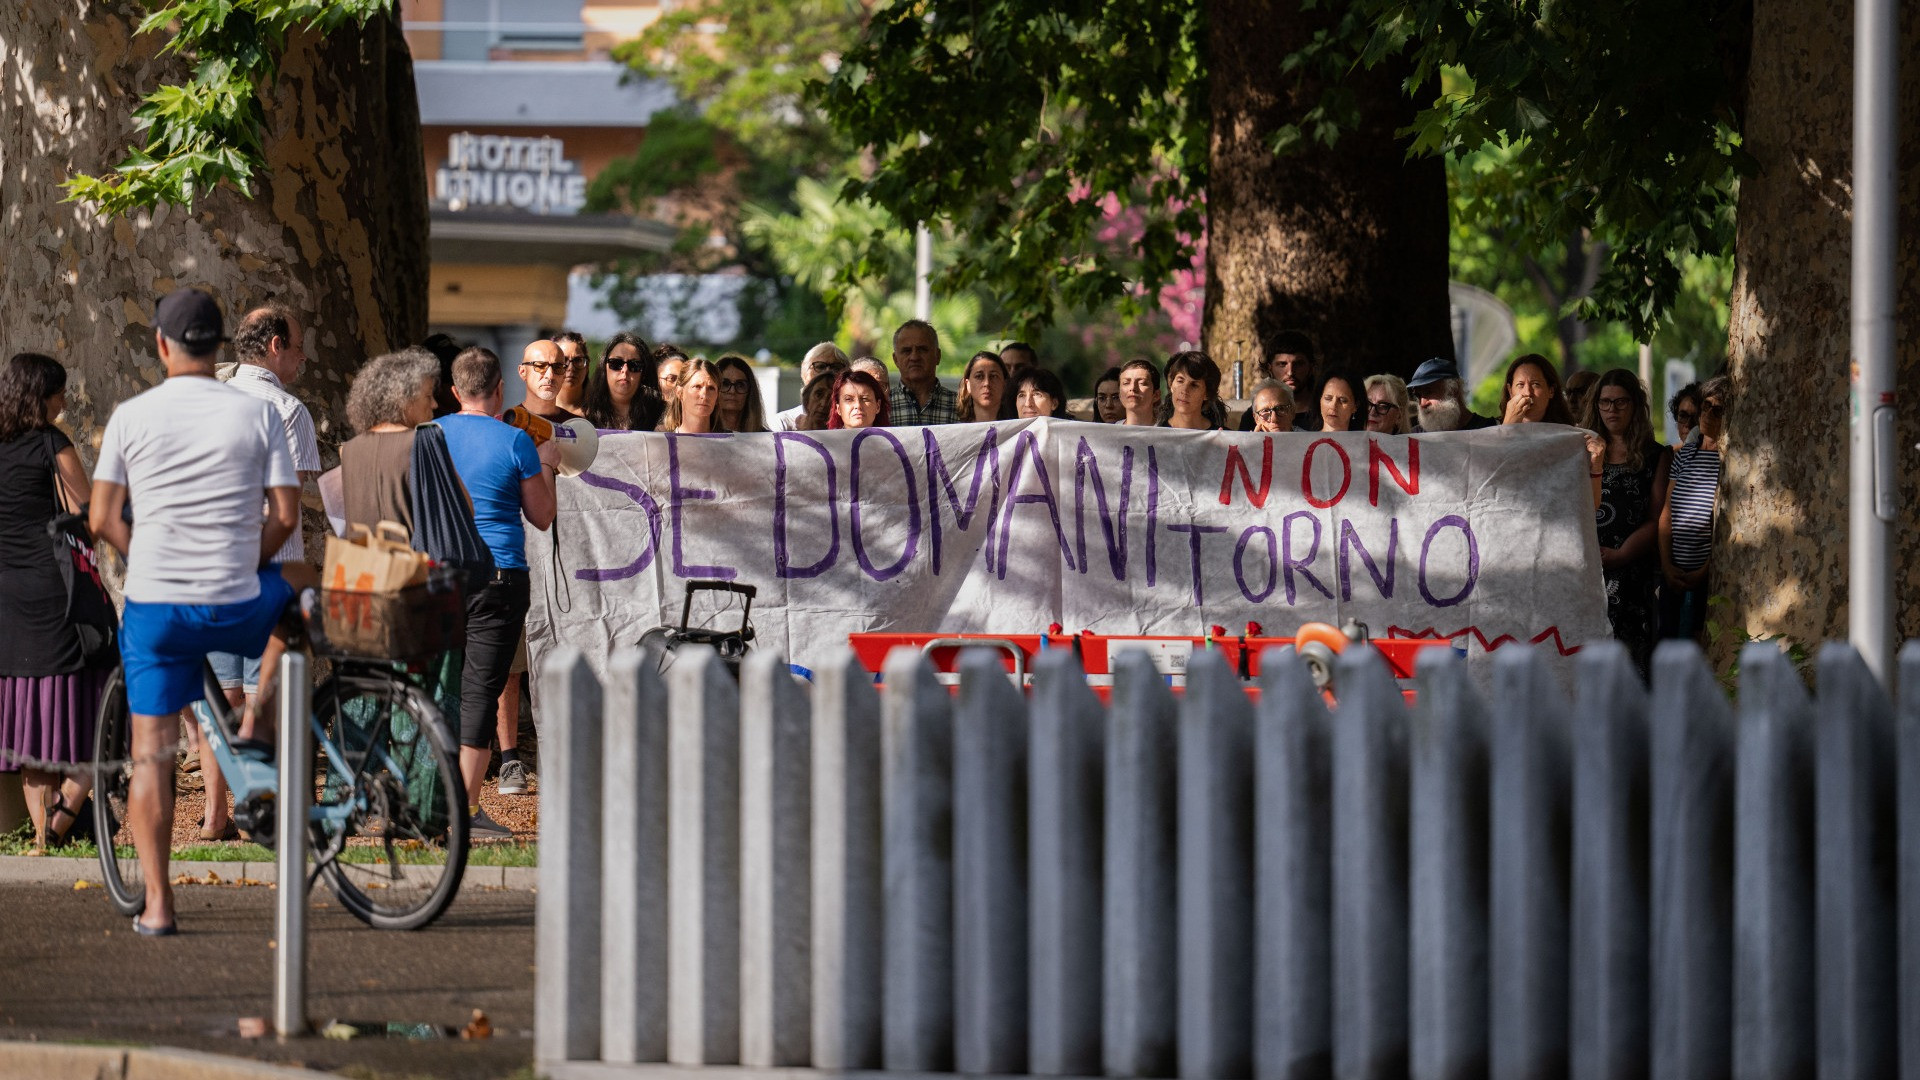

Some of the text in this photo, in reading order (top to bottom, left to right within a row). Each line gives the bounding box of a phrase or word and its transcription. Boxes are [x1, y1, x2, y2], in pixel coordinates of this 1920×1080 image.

[448, 133, 573, 173] HOTEL
[436, 168, 587, 210] UNIONE
[575, 427, 1420, 588] SE DOMANI NON
[1167, 510, 1480, 608] TORNO
